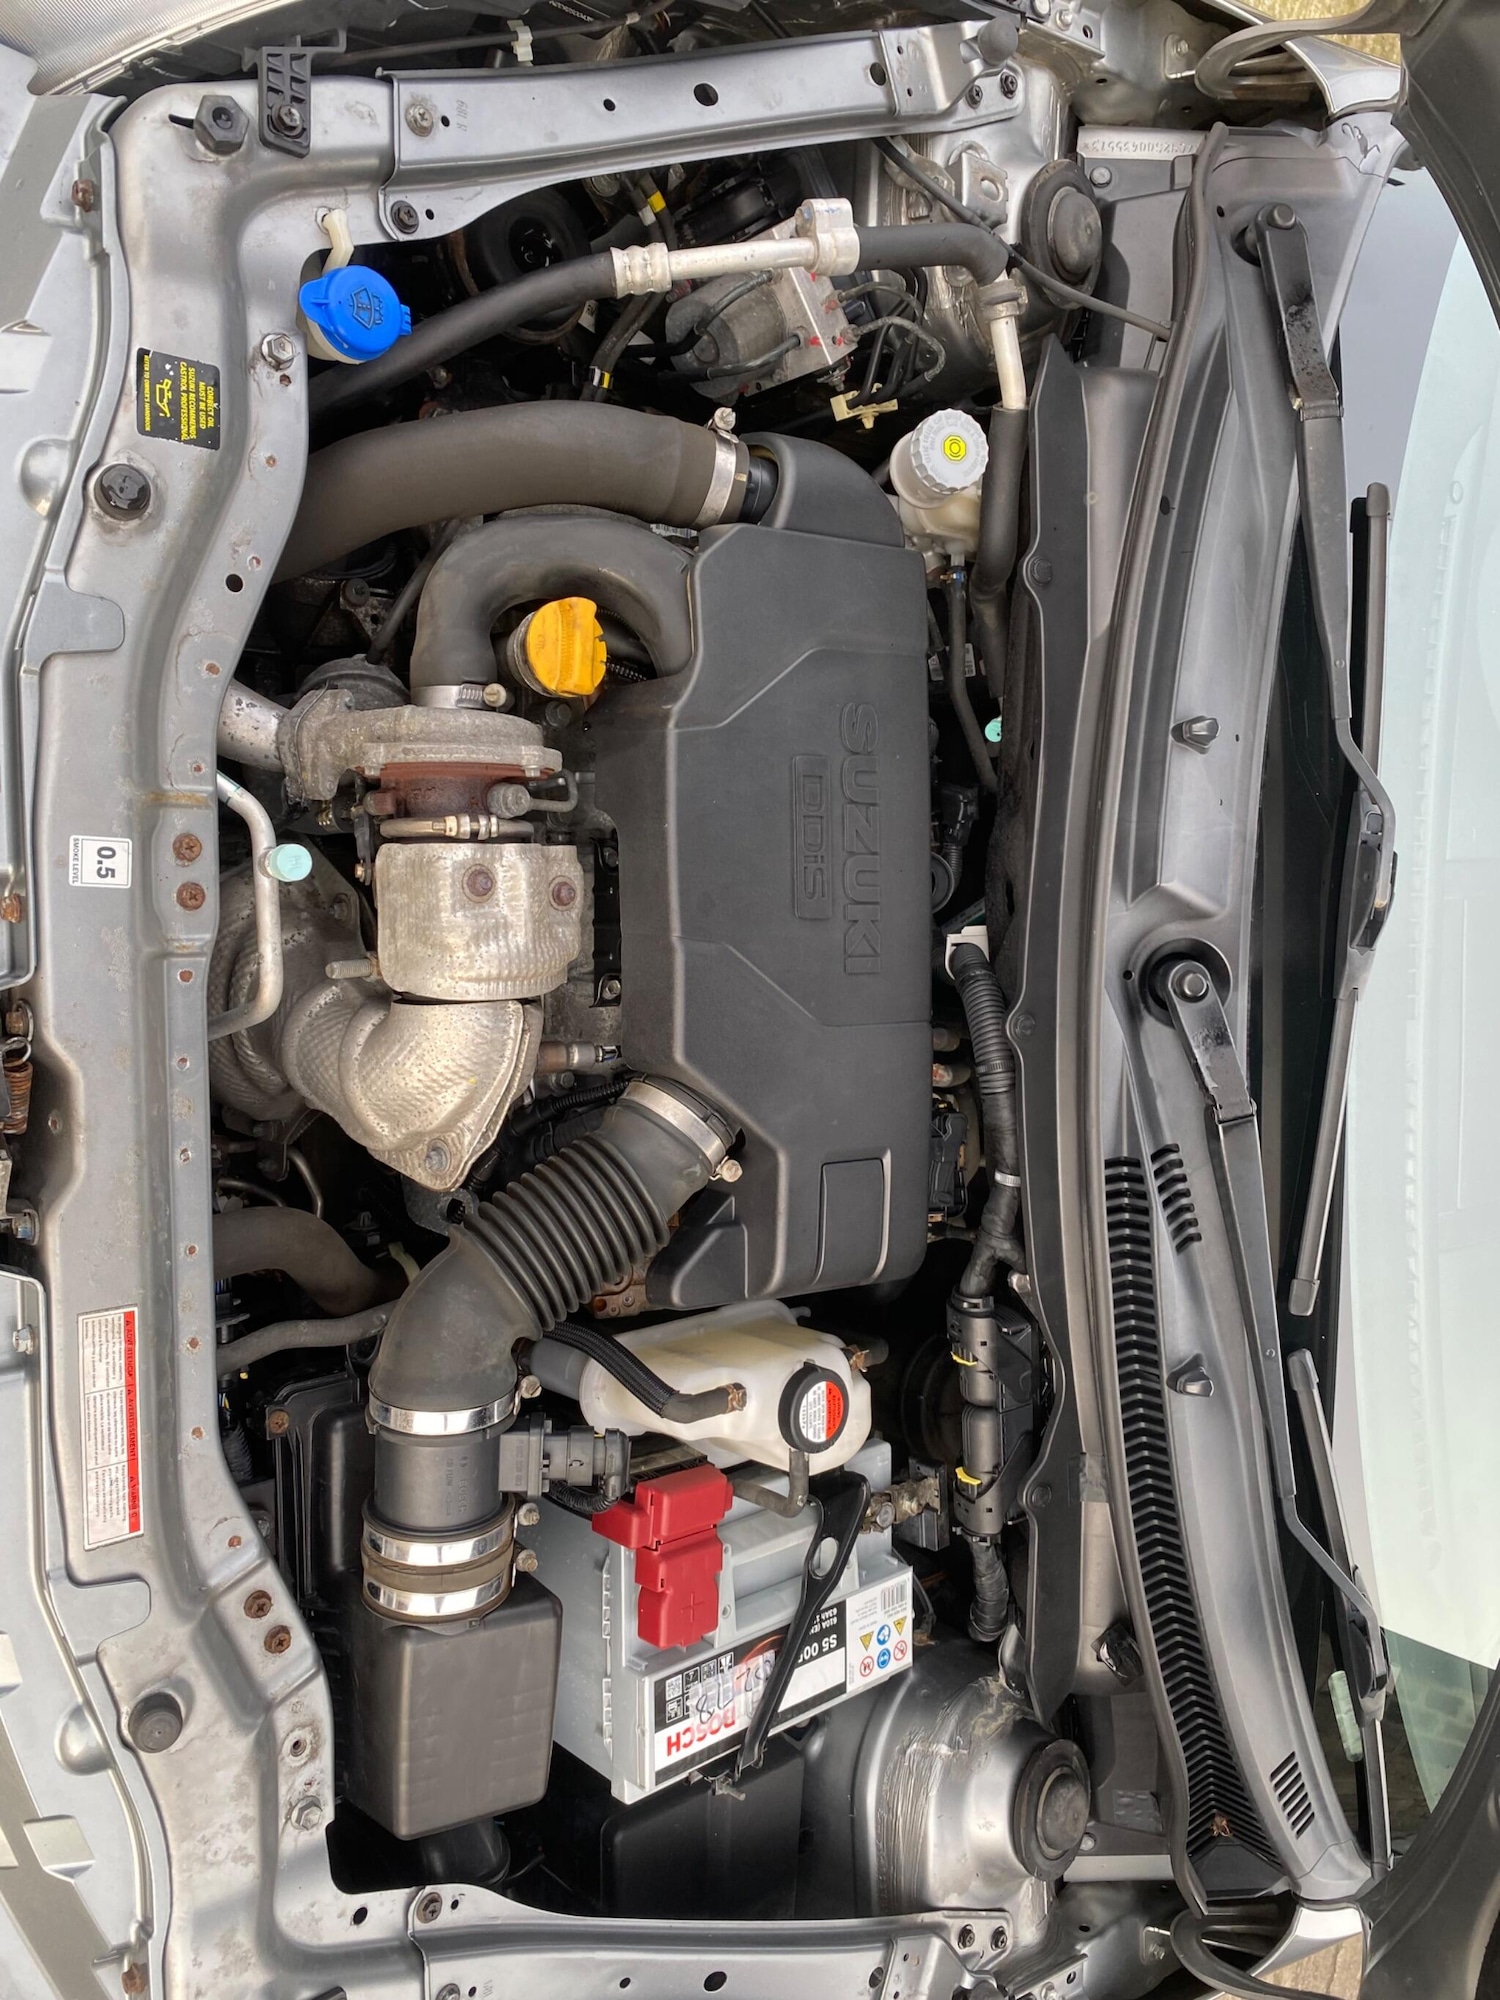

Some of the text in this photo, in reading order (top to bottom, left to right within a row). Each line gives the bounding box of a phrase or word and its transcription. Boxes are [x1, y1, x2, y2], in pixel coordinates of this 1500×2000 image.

[199, 402, 205, 410] BE
[802, 775, 826, 899] DDiS
[841, 702, 880, 974] SUZUKI
[97, 847, 116, 878] 0.5
[446, 1469, 454, 1486] FLOW
[459, 1480, 468, 1513] BOSCH
[822, 1634, 838, 1651] S5
[667, 1703, 736, 1756] BOSCH
